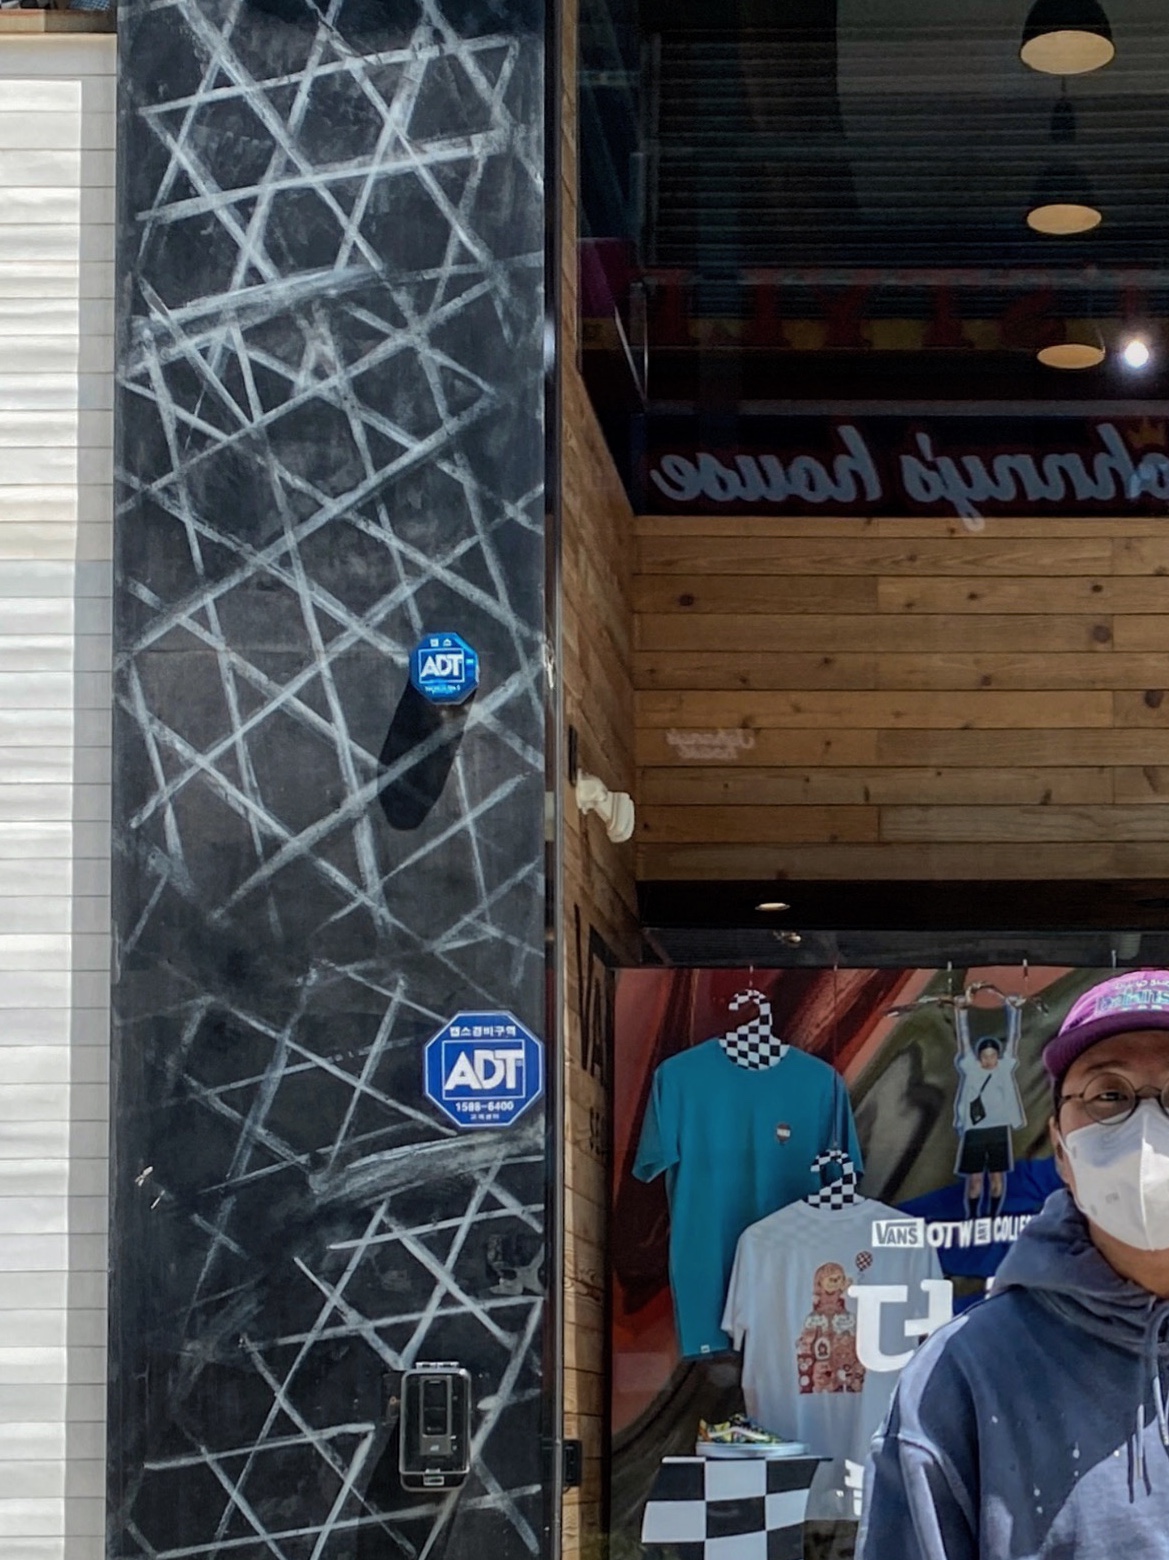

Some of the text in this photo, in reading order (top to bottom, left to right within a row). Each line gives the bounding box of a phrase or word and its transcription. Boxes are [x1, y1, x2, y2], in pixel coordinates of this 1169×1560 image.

[420, 653, 463, 678] ADT
[444, 1049, 524, 1090] ADT
[455, 1101, 515, 1113] 1588-6400
[876, 1222, 919, 1245] VANS
[926, 1219, 974, 1248] OTW
[993, 1214, 1032, 1241] COLLE
